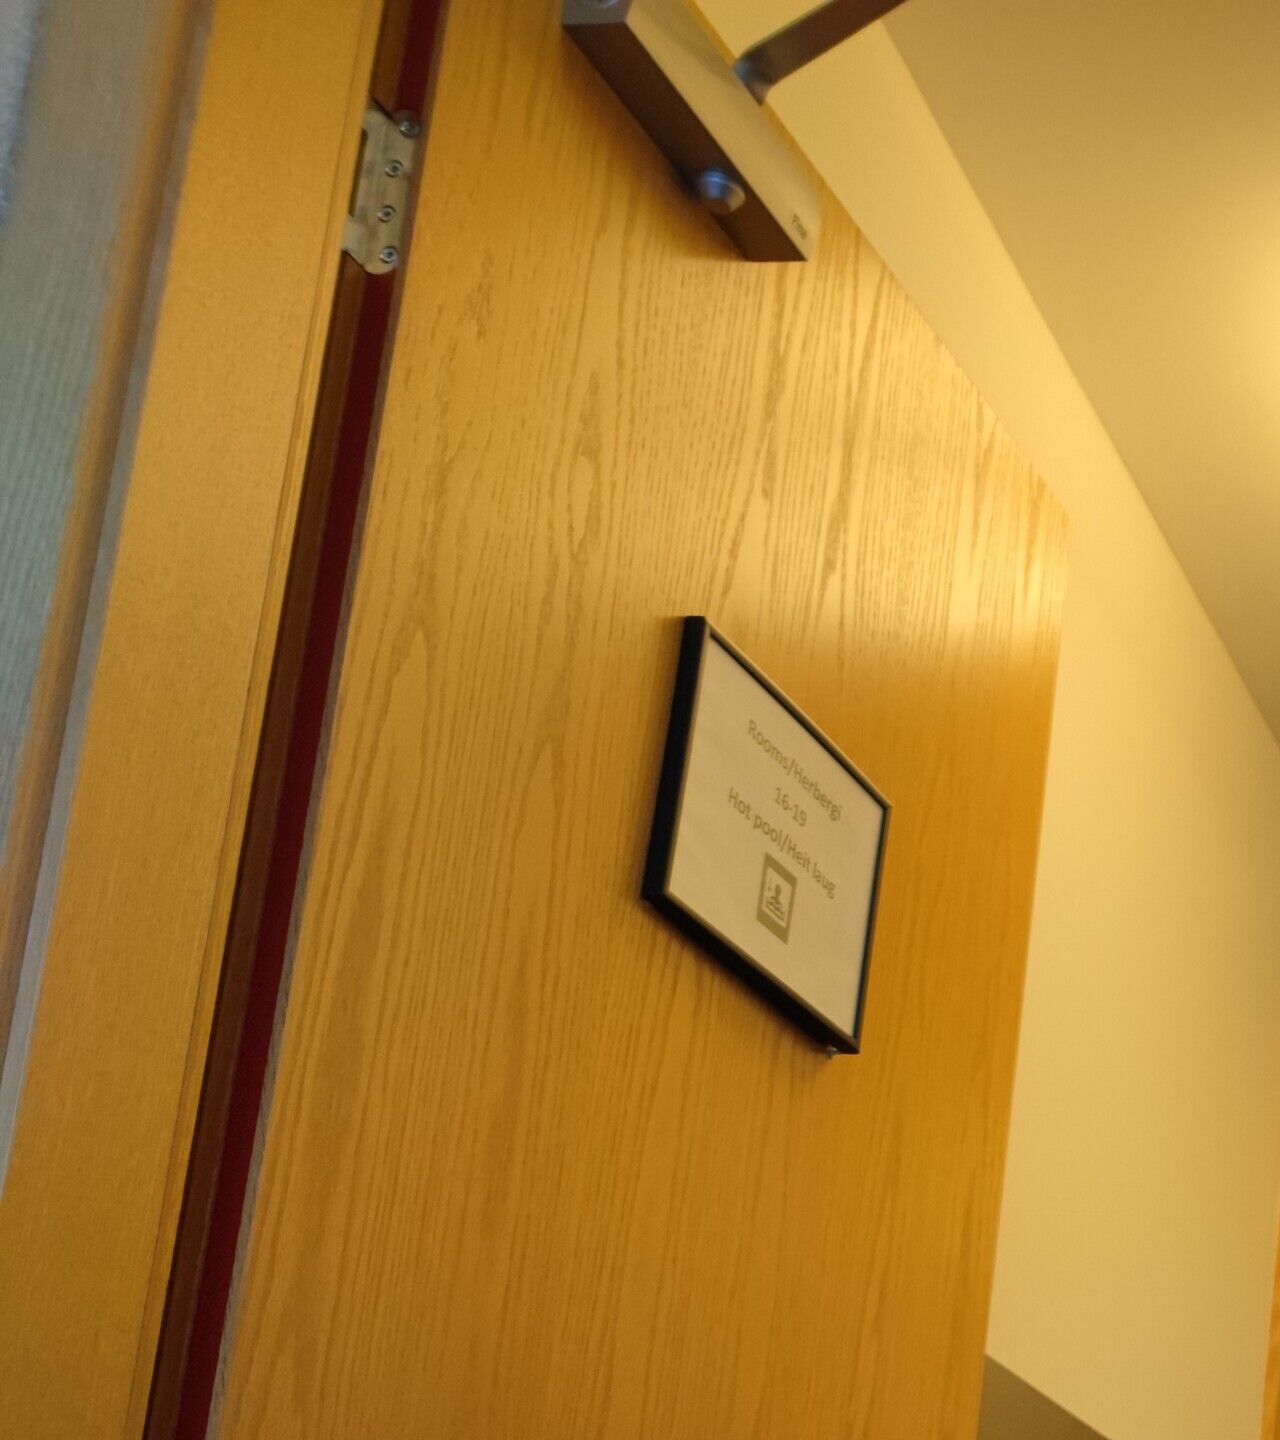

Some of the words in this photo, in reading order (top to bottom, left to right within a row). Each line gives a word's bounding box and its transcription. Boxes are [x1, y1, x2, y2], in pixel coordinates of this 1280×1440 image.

[748, 719, 842, 822] Rooms/Herbergi
[775, 787, 807, 827] 16-19
[728, 787, 751, 820] Hot
[753, 814, 810, 873] pool/Heit
[812, 862, 836, 900] laug
